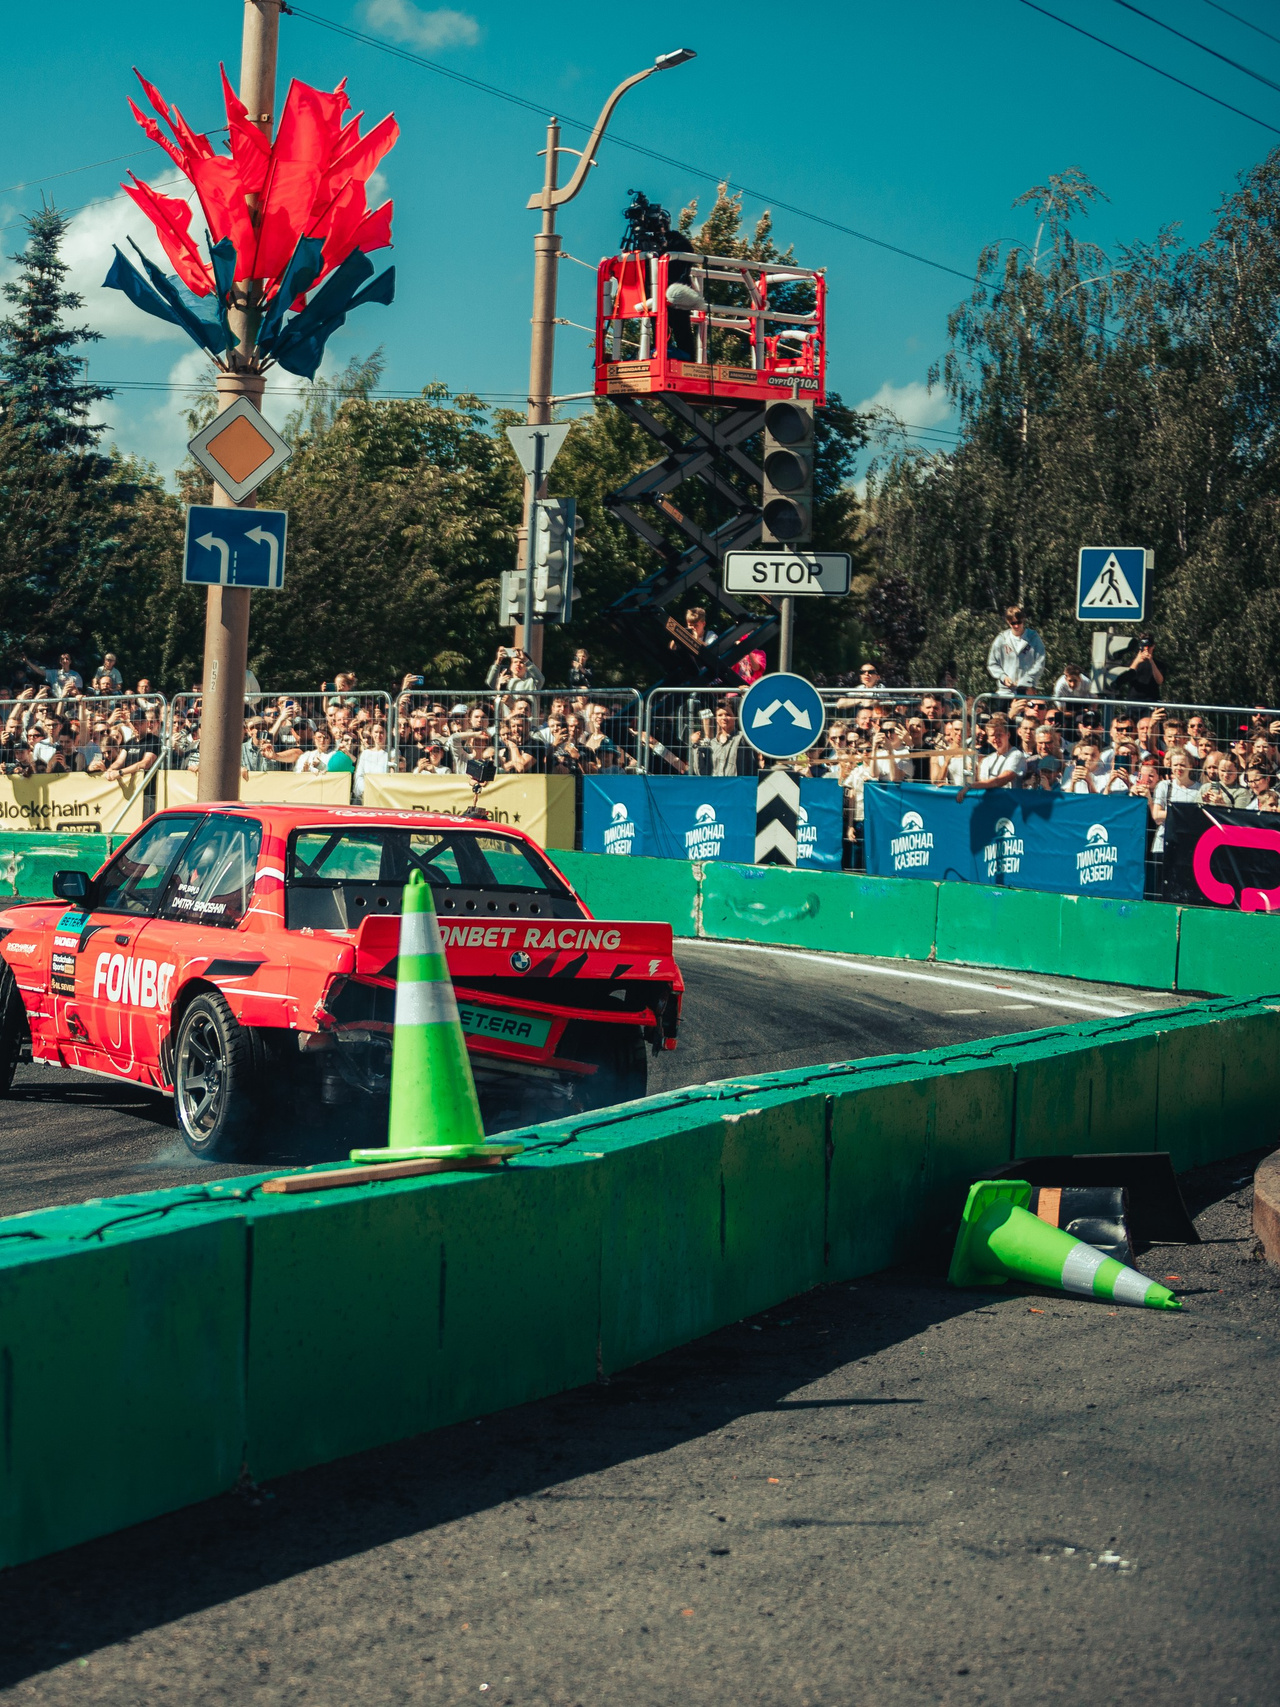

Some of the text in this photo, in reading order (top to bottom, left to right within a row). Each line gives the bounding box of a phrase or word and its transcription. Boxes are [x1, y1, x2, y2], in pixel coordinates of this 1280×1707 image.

[752, 561, 824, 584] STOP
[604, 823, 635, 846] ЛИМОНАД
[685, 823, 725, 848] ЛИМОНАД
[891, 832, 934, 856] ЛИМОНАД
[688, 841, 721, 860] КАЗБЕГИ
[895, 850, 929, 871] КАЗБЕГИ
[984, 839, 1024, 862] ЛИМОНАД
[1076, 846, 1118, 870] ЛИМОНАД
[987, 857, 1020, 877] КАЗБЕГИ
[1080, 865, 1114, 885] КАЗБЕГИ
[171, 897, 195, 910] DMITRY
[439, 926, 621, 950] ONBET RACING
